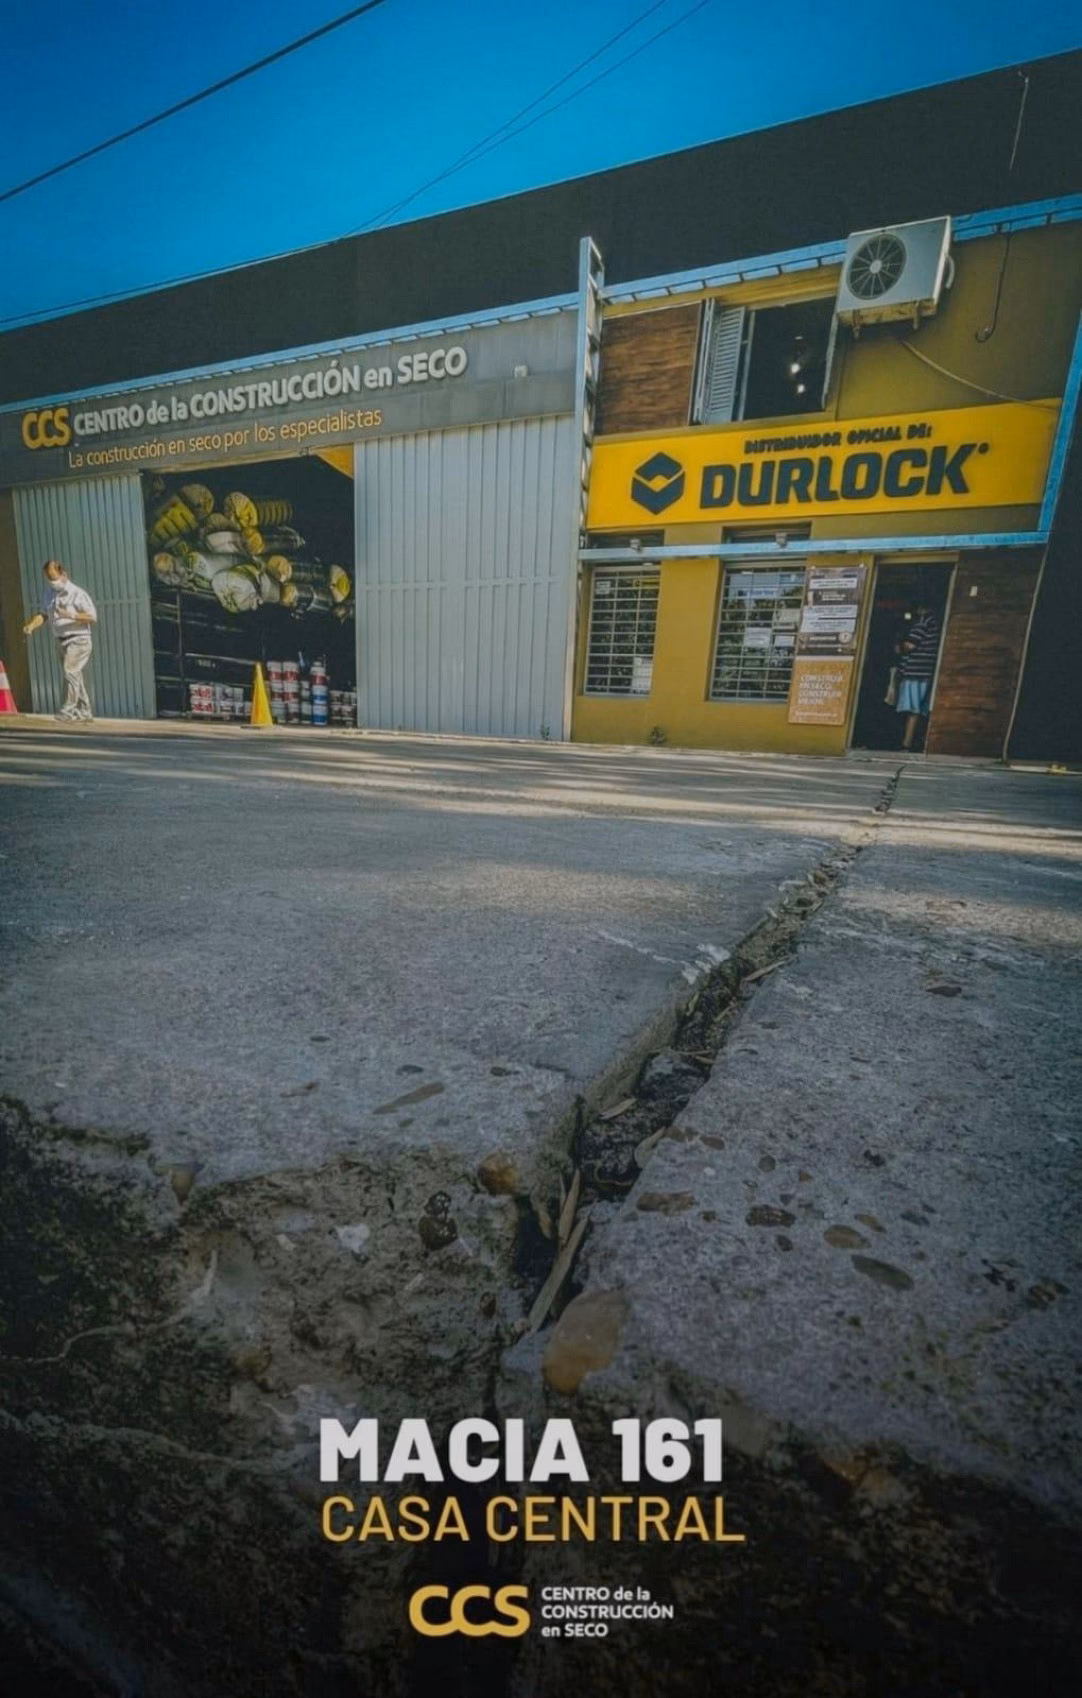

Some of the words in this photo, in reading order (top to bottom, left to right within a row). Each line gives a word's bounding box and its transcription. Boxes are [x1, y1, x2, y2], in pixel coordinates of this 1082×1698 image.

[22, 407, 72, 449] CCS
[74, 404, 145, 436] CENTRO
[146, 400, 169, 425] de
[171, 397, 188, 421] la
[190, 360, 361, 418] CONSTRUCCIÓN
[364, 366, 393, 389] en
[397, 346, 468, 385] SECO
[68, 451, 84, 469] La
[87, 438, 166, 466] construcción
[169, 440, 186, 455] en
[189, 431, 221, 452] seco
[224, 430, 250, 452] por
[254, 422, 276, 442] los
[280, 408, 382, 443] especialistas
[744, 431, 842, 455] DISTRIBUIDOR
[847, 426, 902, 445] OFICIAL
[699, 442, 980, 509] DURLOCK
